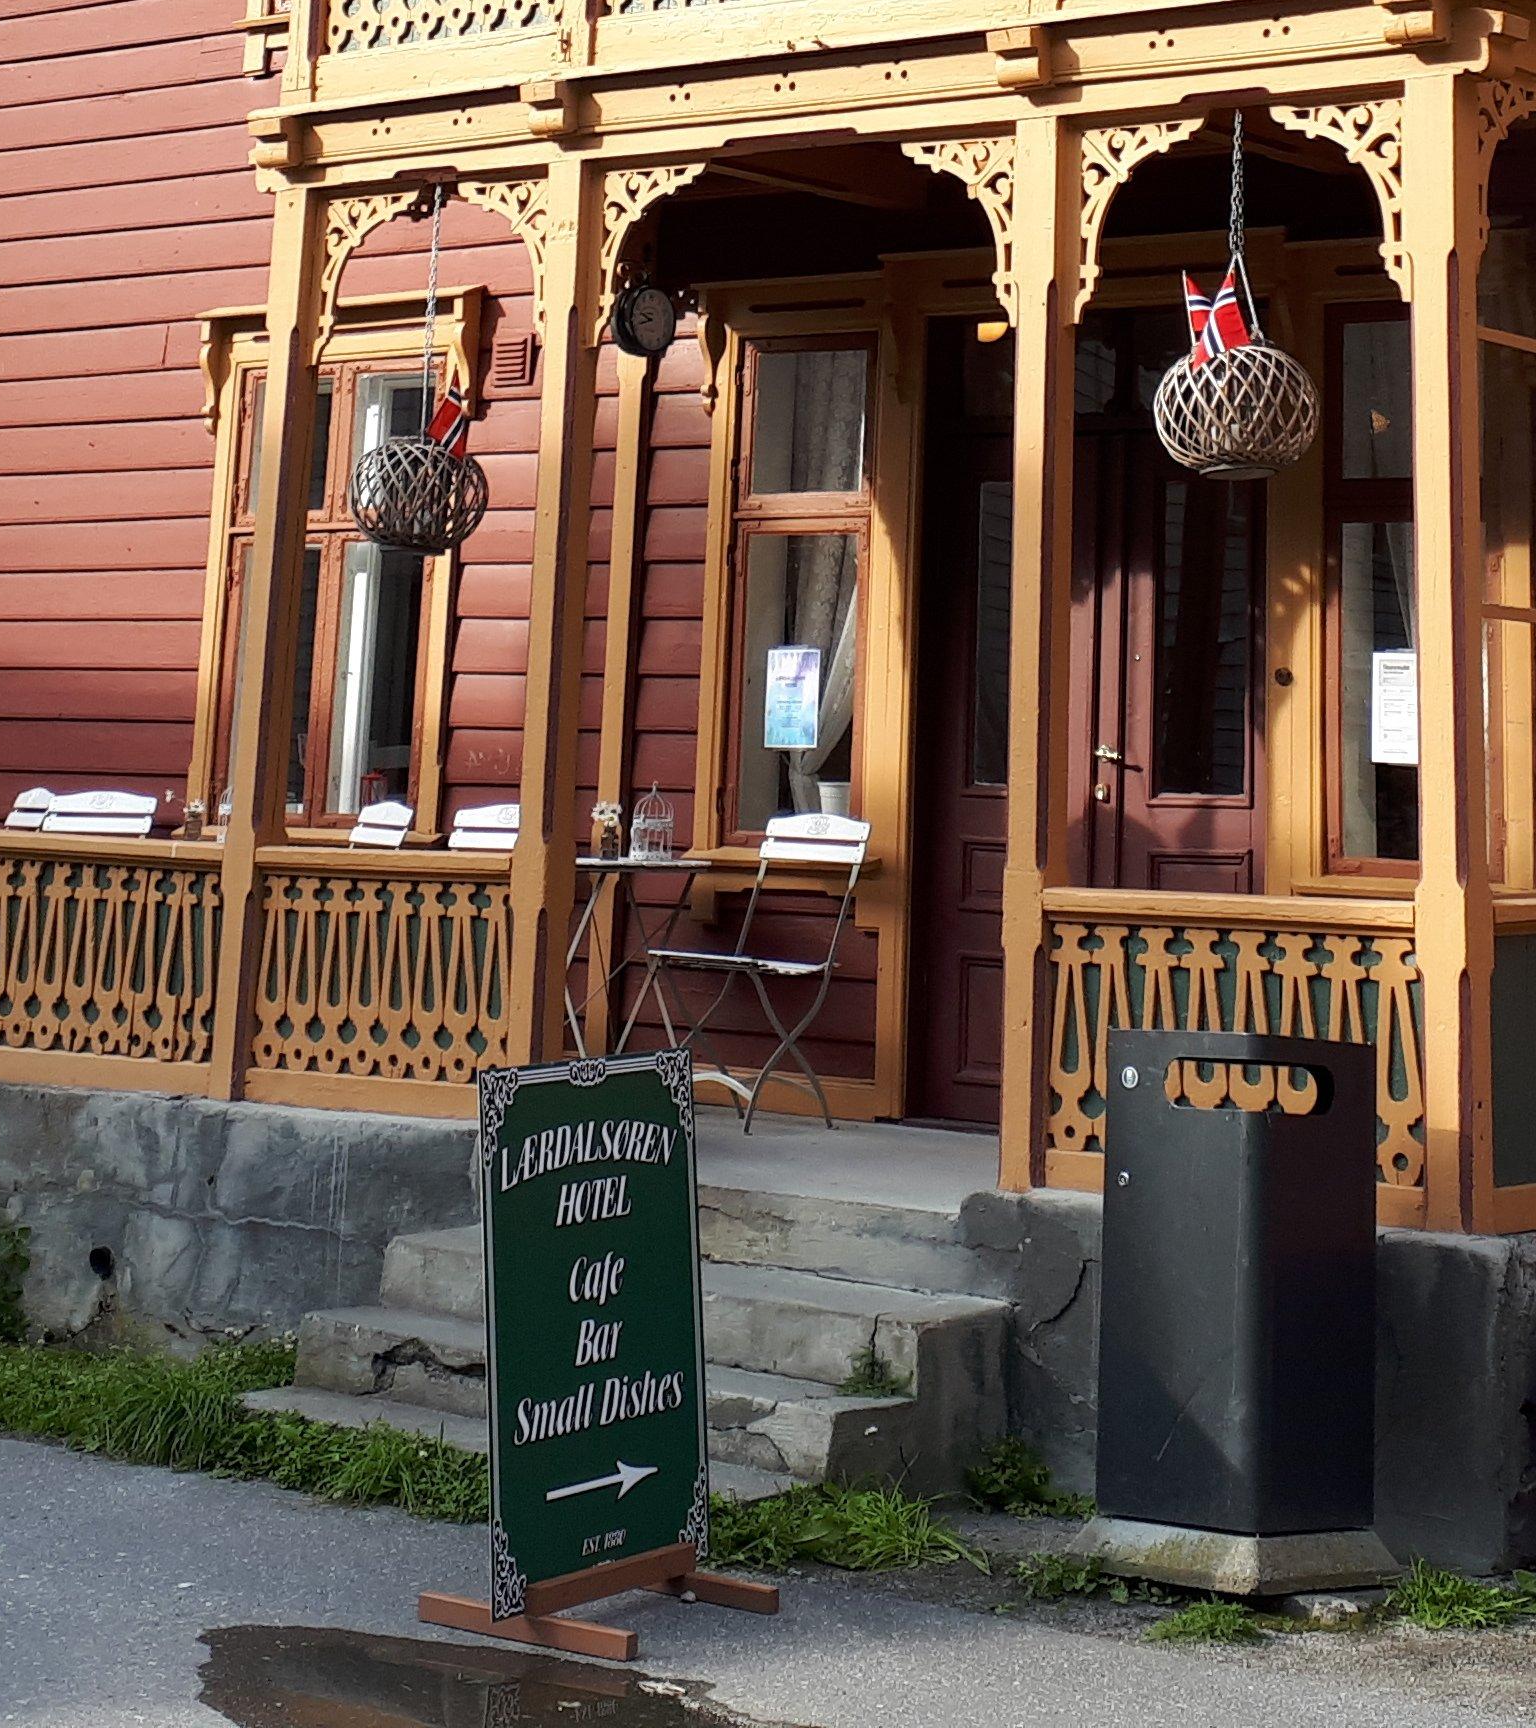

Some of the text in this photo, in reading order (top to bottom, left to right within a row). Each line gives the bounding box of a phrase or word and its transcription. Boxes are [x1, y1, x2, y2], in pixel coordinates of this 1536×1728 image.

[500, 1119, 678, 1193] LÆRDALSØREN
[555, 1174, 632, 1227] HOTEL
[569, 1251, 625, 1306] Cafe
[575, 1319, 624, 1367] Bar
[514, 1370, 684, 1446] Small Dishes
